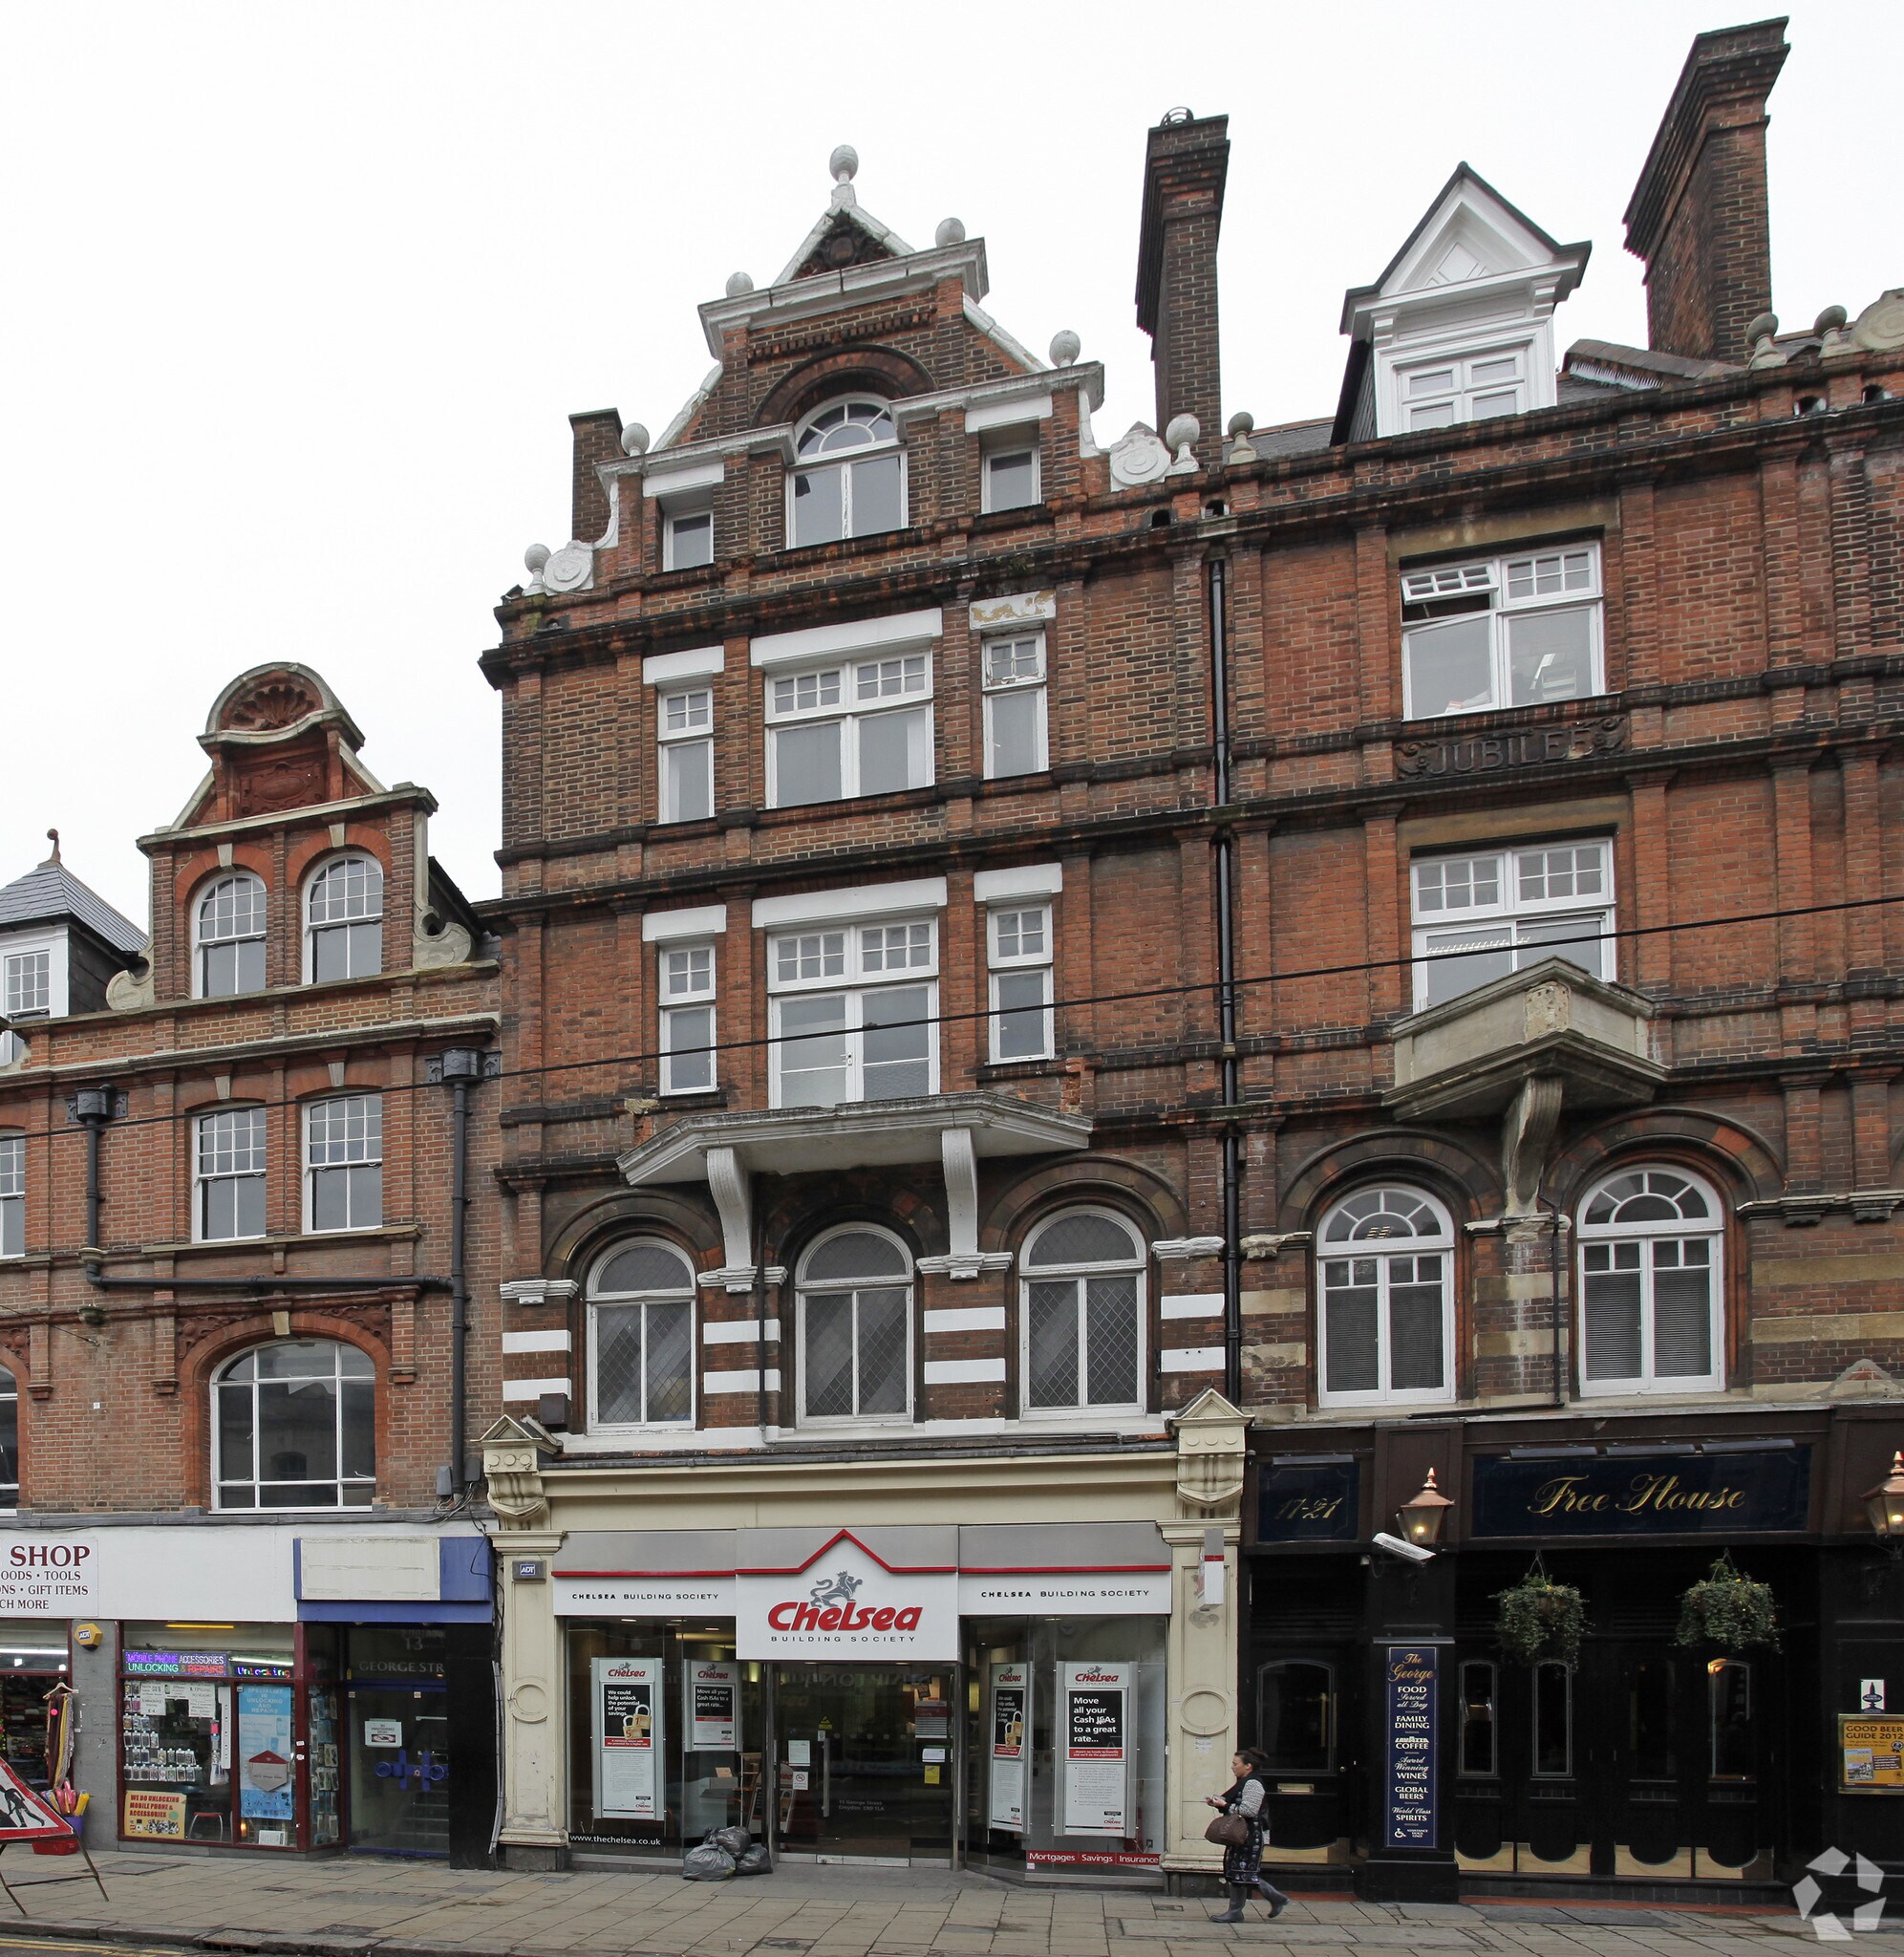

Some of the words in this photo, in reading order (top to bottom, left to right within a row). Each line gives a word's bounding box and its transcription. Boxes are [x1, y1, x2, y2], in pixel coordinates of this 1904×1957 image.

[1426, 727, 1594, 775] JUBILEE
[1527, 1474, 1611, 1517] Free
[1615, 1473, 1746, 1516] House
[1274, 1497, 1343, 1519] 17-21
[10, 1545, 91, 1567] SHOP
[44, 1571, 81, 1581] TOOLS
[28, 1585, 52, 1595] GIFT
[55, 1585, 89, 1596] ITEMS
[17, 1600, 50, 1609] MORE
[767, 1601, 924, 1632] Chelsea
[405, 1637, 423, 1650] 13
[126, 1654, 153, 1664] MOBILE
[155, 1654, 178, 1664] PHONE
[179, 1654, 225, 1665] ACCESSORIES
[1402, 1653, 1423, 1664] The
[128, 1663, 179, 1672] UNLOCKING
[187, 1665, 225, 1673] REPAIRS
[358, 1661, 417, 1672] GEORGE
[237, 1667, 290, 1678] Unlocking
[608, 1668, 647, 1678] Chelsea
[697, 1669, 729, 1679] Chelsea
[998, 1673, 1022, 1683] Chelsea
[1075, 1673, 1120, 1683] Chelsea
[1388, 1663, 1434, 1685] George
[1409, 1701, 1428, 1710] Day
[1092, 1726, 1117, 1734] great
[1395, 1762, 1429, 1773] Winning
[569, 1835, 661, 1846] www.thechelsea.co.uk
[1029, 1853, 1076, 1862] Mortgages
[1081, 1854, 1113, 1863] Savings
[1119, 1855, 1159, 1863] Insurance
